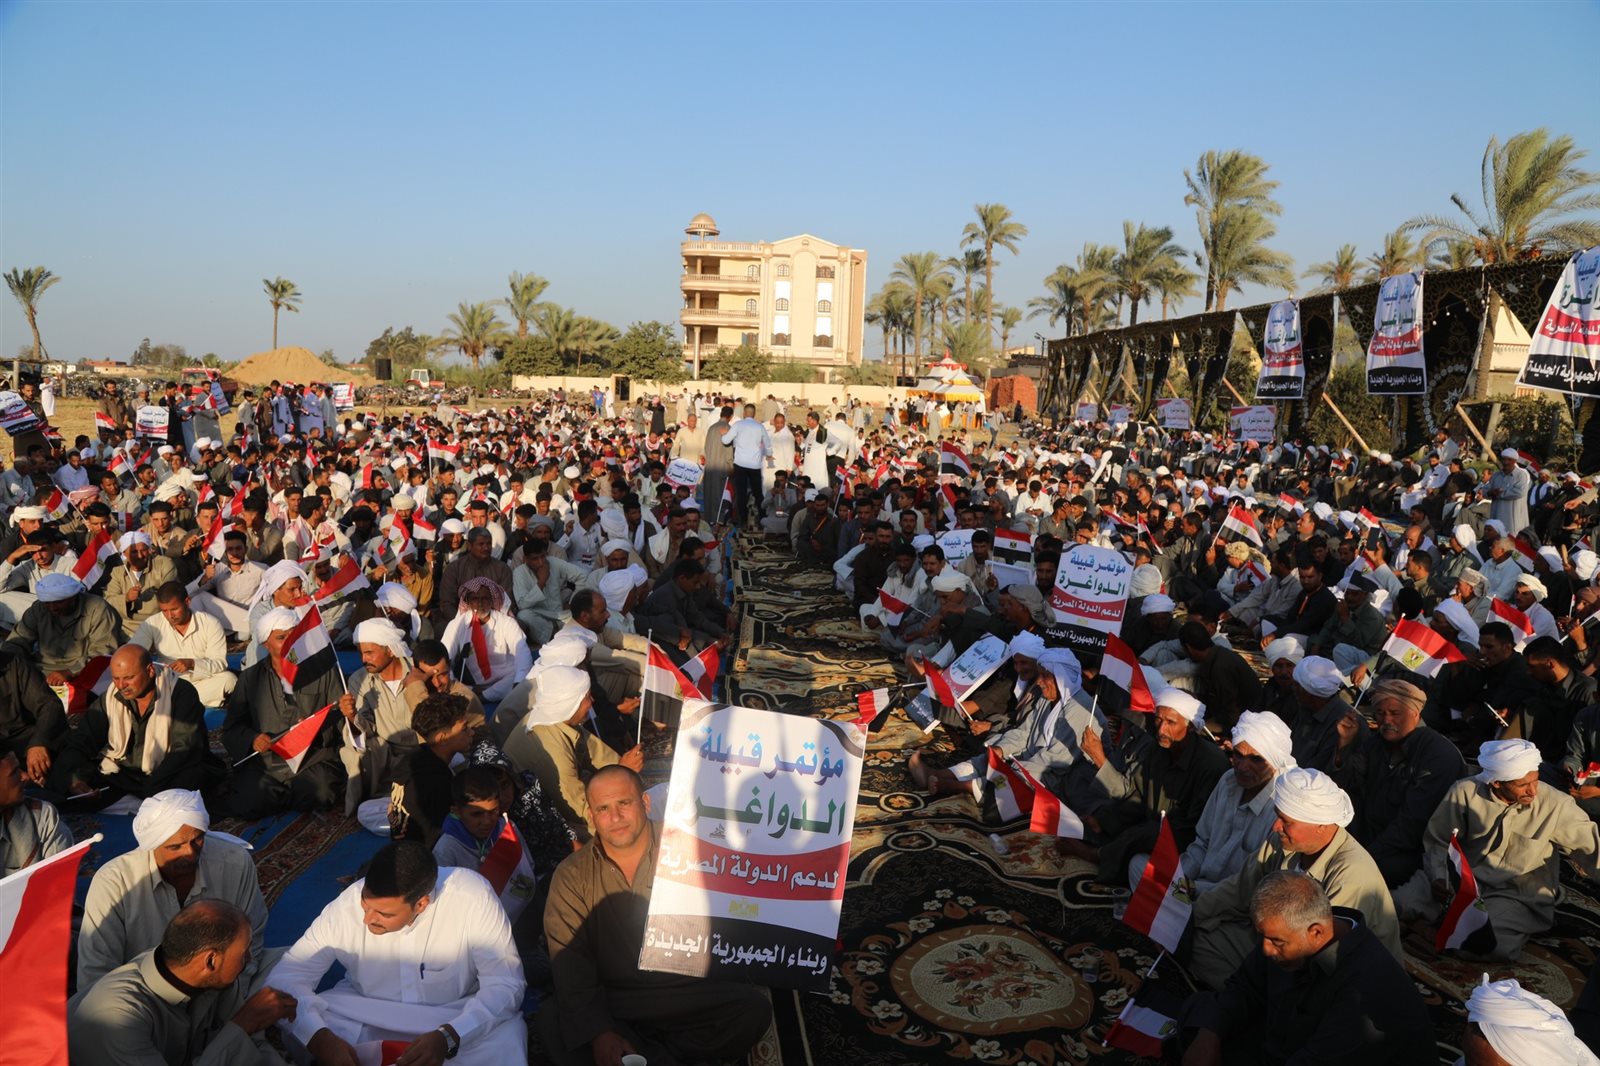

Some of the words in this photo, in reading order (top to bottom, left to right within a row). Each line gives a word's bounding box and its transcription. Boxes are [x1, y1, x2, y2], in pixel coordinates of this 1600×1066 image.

[1070, 551, 1095, 571] قبيلة
[1095, 558, 1126, 576] مؤتمر
[1059, 570, 1126, 596] الدواغرة
[1053, 595, 1077, 608] المصرية
[1079, 600, 1101, 613] الدولة
[1101, 608, 1121, 617] لدعم
[1069, 629, 1098, 646] الجمهورية
[1097, 633, 1109, 647] ناء
[699, 726, 763, 776] قبيلة
[764, 742, 844, 786] مؤتمر
[660, 844, 727, 877] المصرية
[729, 854, 788, 885] الدولة
[790, 869, 839, 891] لدعم
[645, 927, 709, 959] الجديدة
[712, 932, 786, 969] الجمهورية
[788, 945, 828, 976] وبناء
